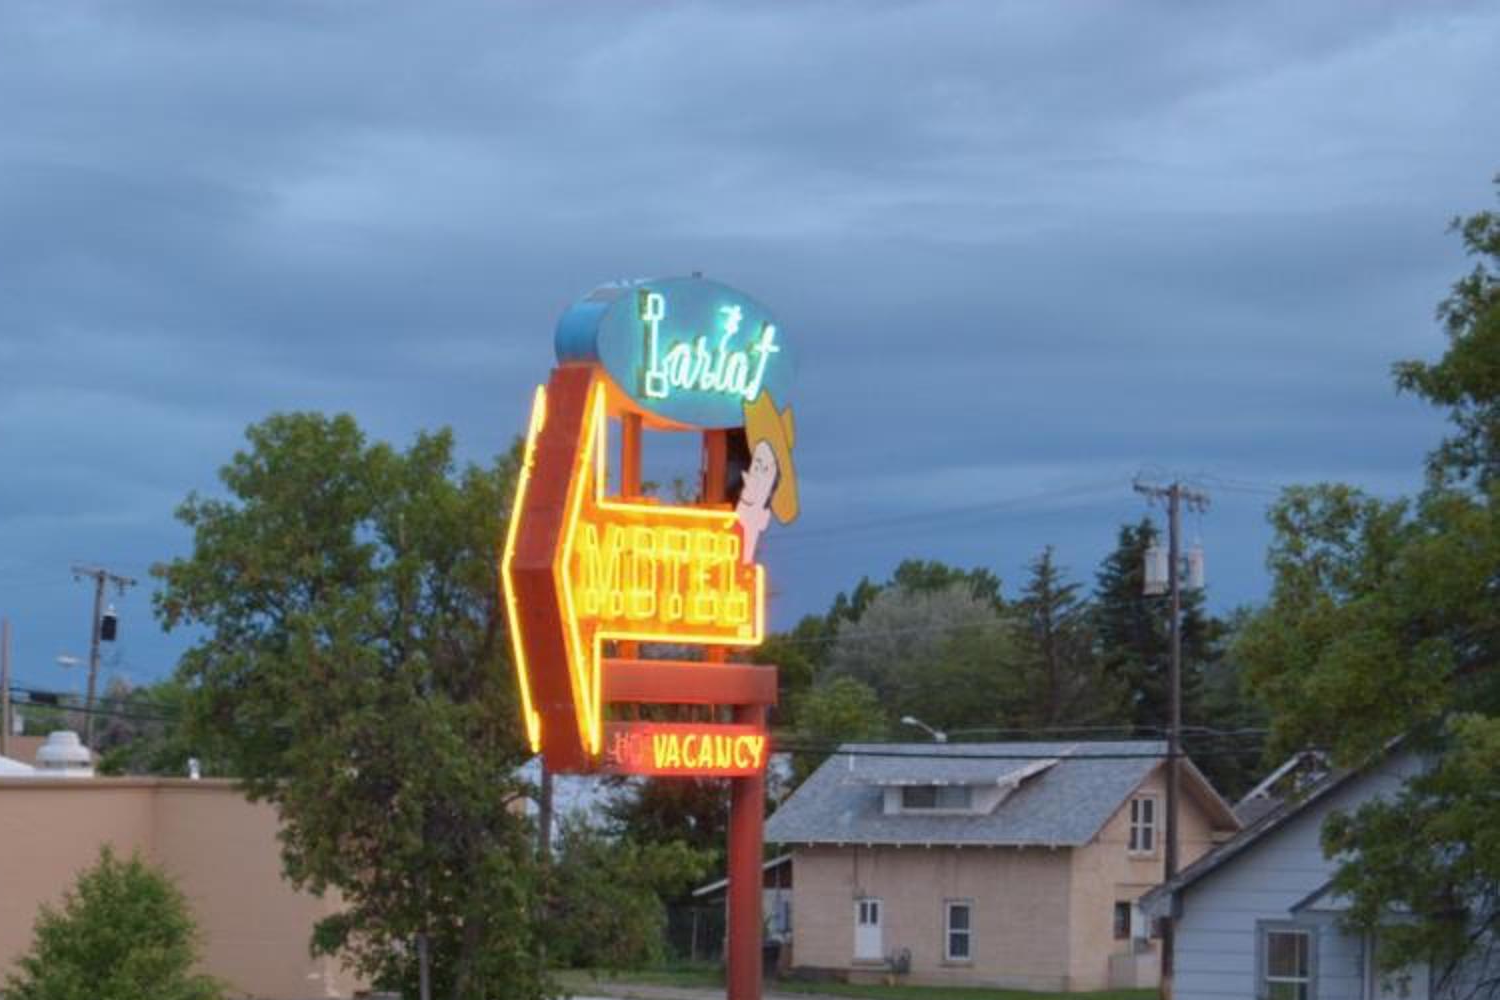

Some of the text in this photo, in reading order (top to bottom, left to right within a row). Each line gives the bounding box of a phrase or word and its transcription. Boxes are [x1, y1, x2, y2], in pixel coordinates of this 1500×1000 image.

[641, 291, 780, 402] Lariat
[581, 523, 749, 624] MOTEL
[653, 734, 764, 768] VACANCY
